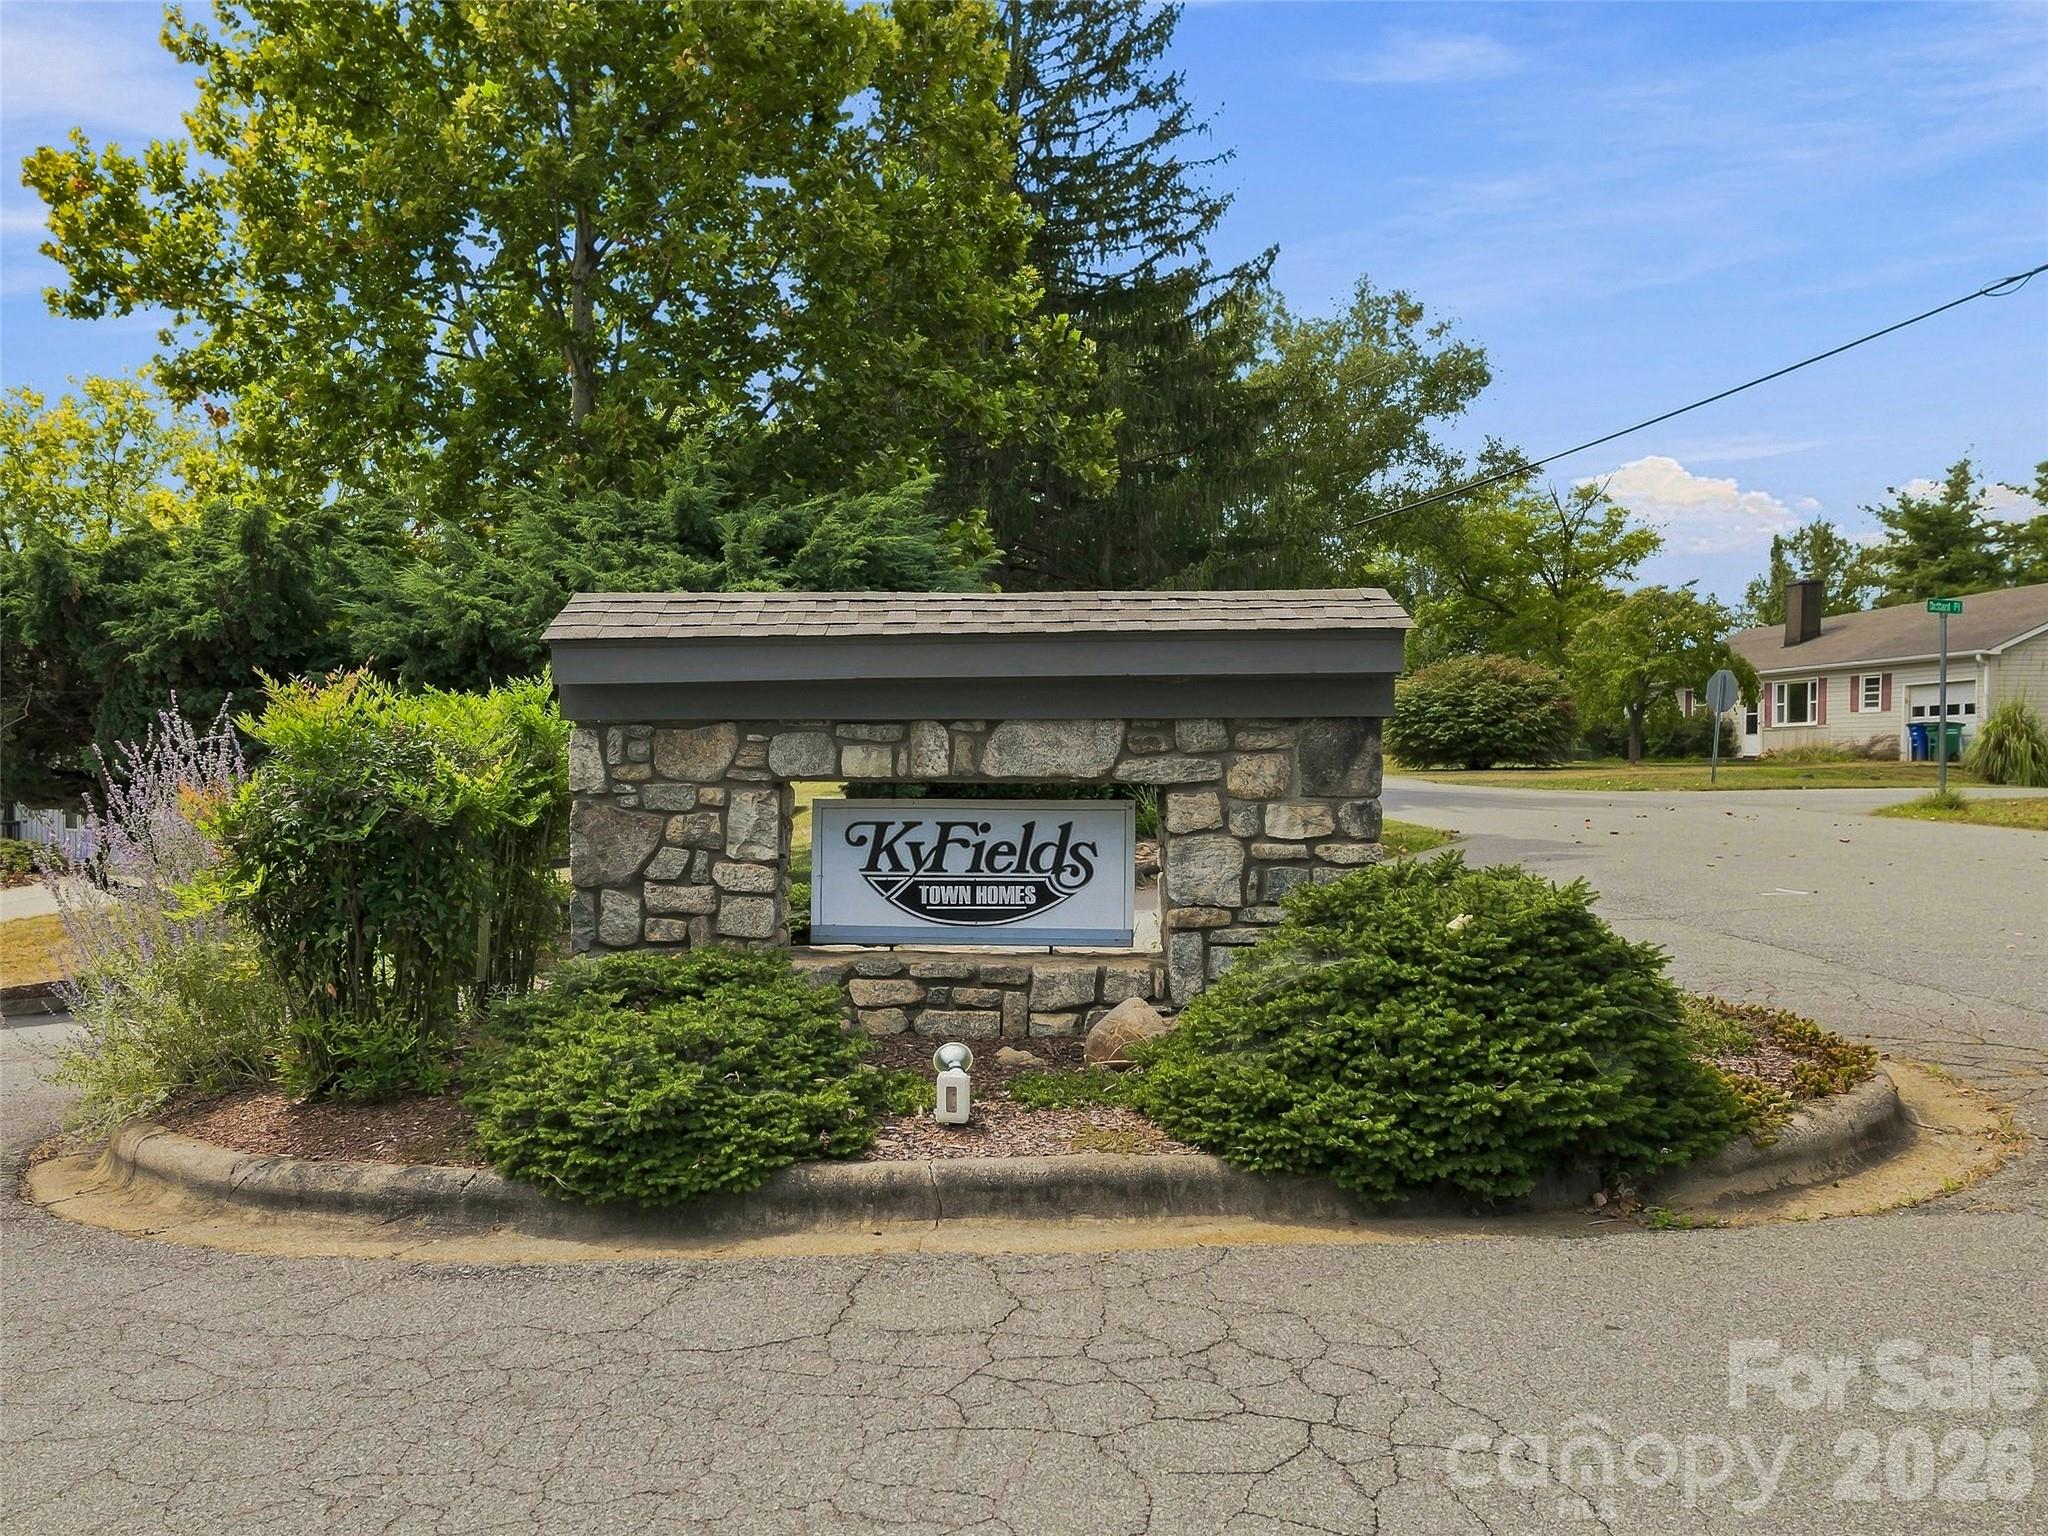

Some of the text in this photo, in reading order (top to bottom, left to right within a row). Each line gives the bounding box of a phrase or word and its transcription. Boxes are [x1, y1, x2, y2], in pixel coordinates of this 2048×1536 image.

[845, 820, 1099, 889] KyFields
[919, 885, 1037, 905] TOWN HOMES
